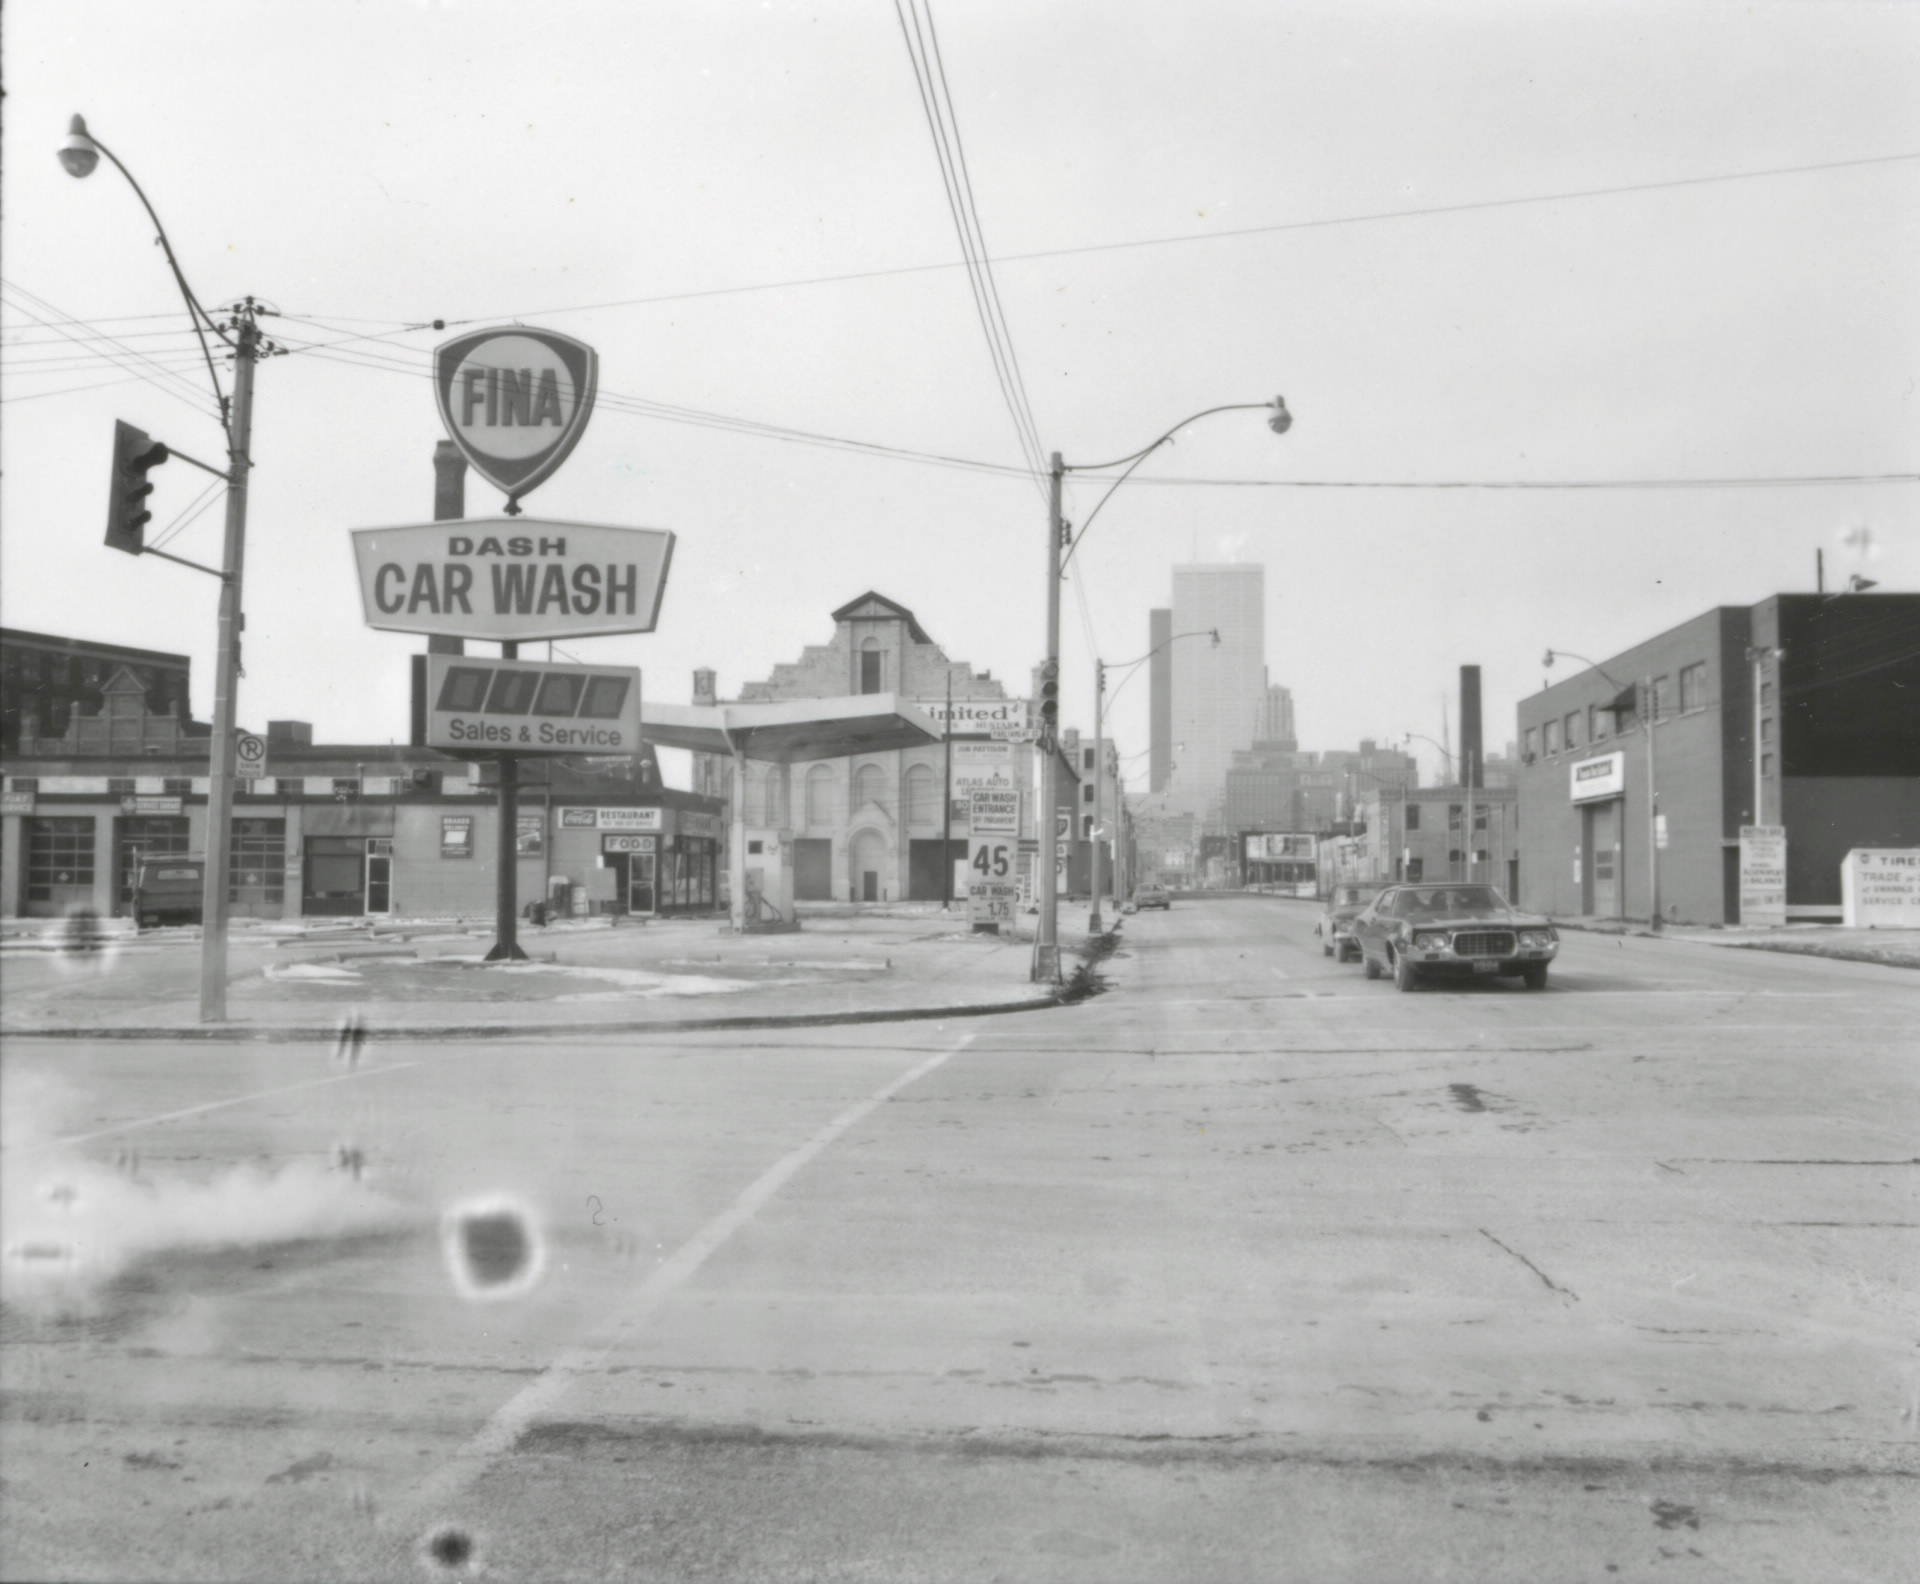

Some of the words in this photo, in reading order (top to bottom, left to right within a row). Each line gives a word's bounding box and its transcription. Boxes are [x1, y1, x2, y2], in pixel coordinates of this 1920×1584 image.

[462, 367, 562, 427] FINA
[448, 537, 567, 556] DASH
[375, 563, 474, 616] CAR
[492, 563, 637, 616] WASH
[449, 719, 511, 742] Sales
[518, 726, 531, 743] &
[539, 722, 622, 746] Service
[956, 778, 983, 787] ATLAS
[986, 778, 1009, 787] AUTO
[973, 793, 990, 802] CAR
[992, 794, 1017, 803] WASH
[973, 804, 1016, 813] ENTRANCE
[600, 811, 655, 819] RESTAURANT
[609, 838, 653, 849] FOOD
[973, 845, 1009, 876] 45
[1880, 856, 1920, 866] TIRE
[1863, 872, 1901, 882] TRADE
[970, 886, 987, 896] CAR
[991, 886, 1014, 896] WASH
[1862, 897, 1902, 905] SERVICE
[988, 902, 1009, 916] 1.75
